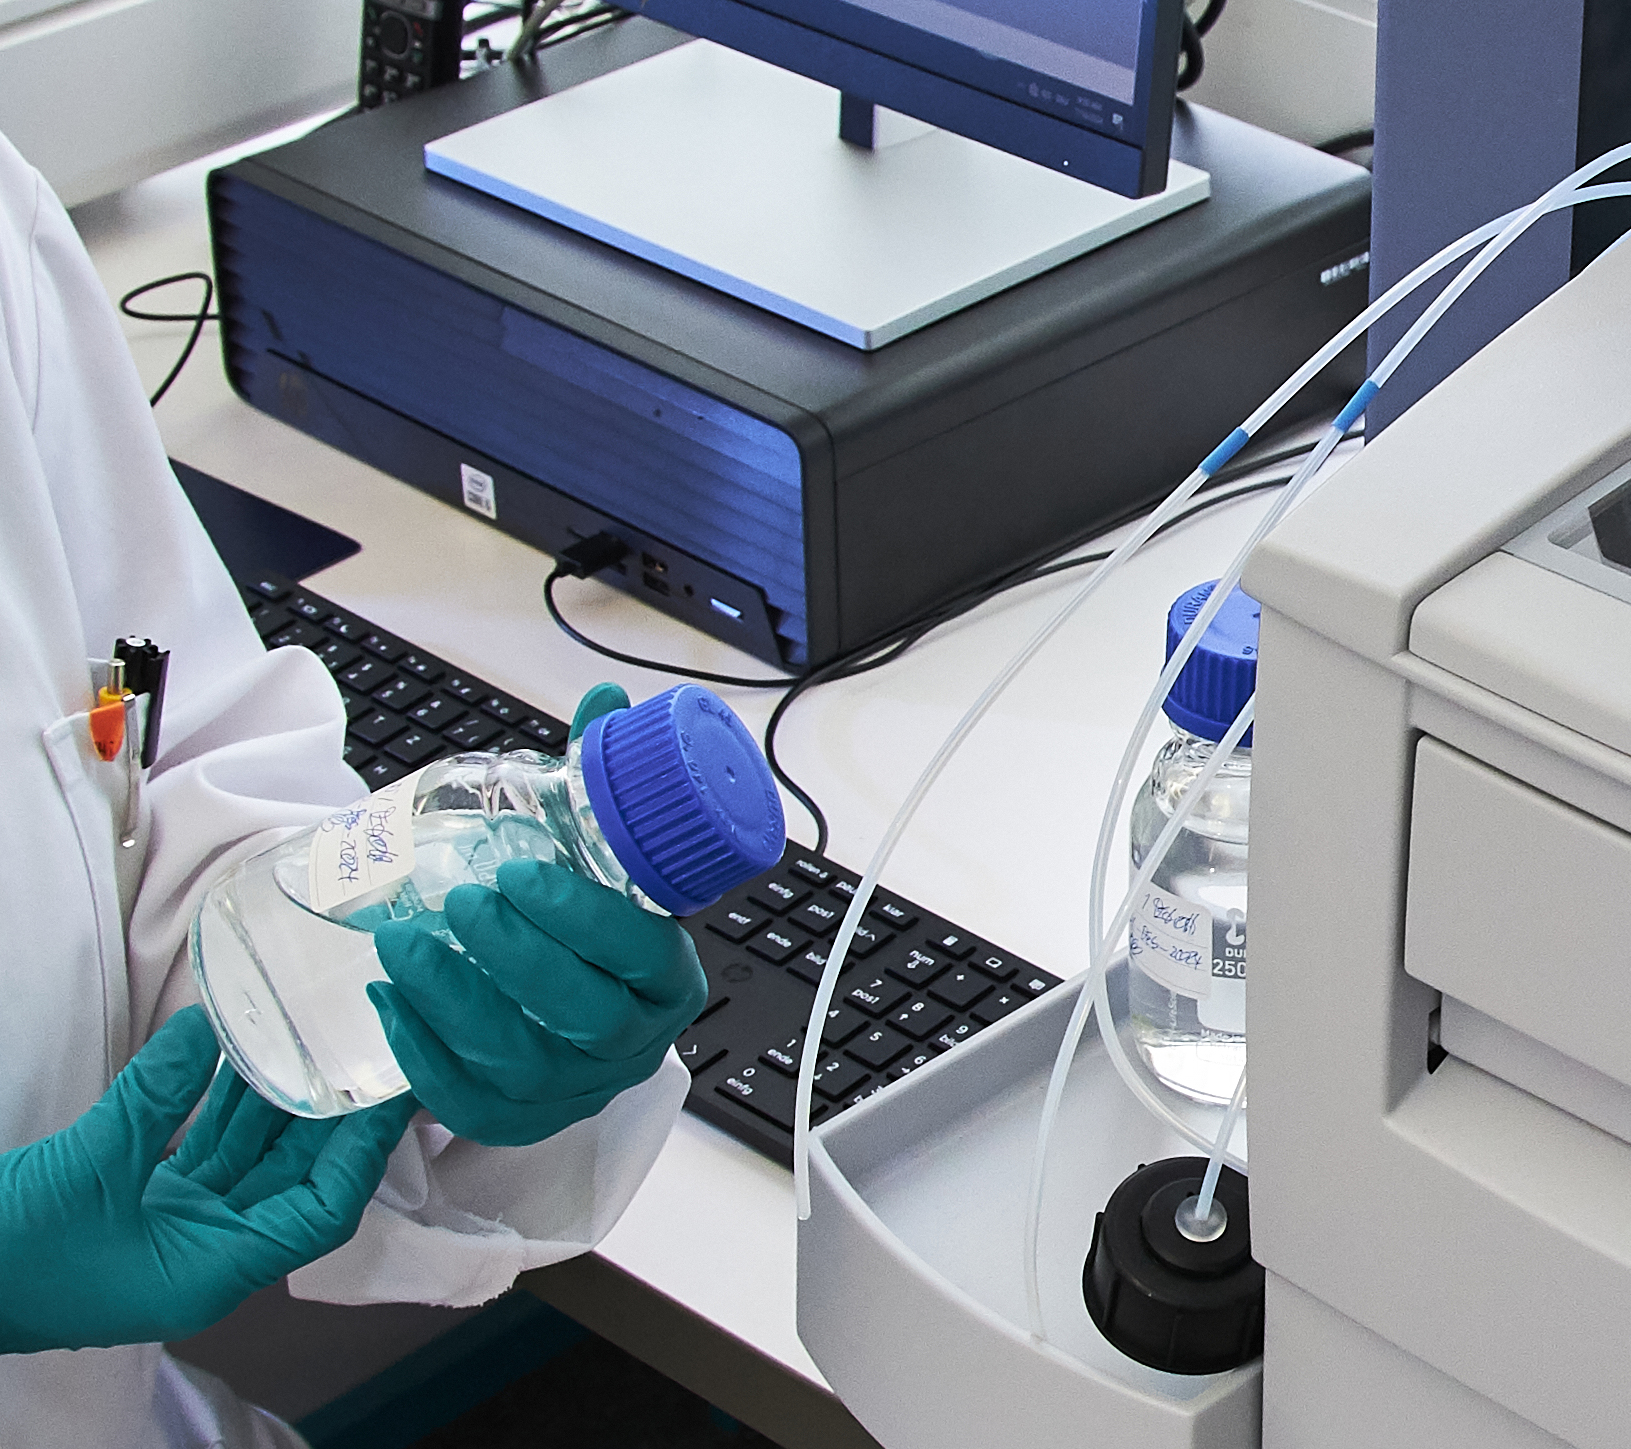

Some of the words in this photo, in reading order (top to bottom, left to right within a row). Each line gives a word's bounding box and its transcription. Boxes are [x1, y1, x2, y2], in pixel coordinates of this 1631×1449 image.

[870, 979, 882, 988] 7
[912, 1002, 925, 1012] 8
[956, 1025, 969, 1035] 9
[869, 1031, 883, 1041] 5
[787, 1039, 797, 1048] 1
[914, 1055, 927, 1065] 6
[826, 1062, 840, 1073] 2
